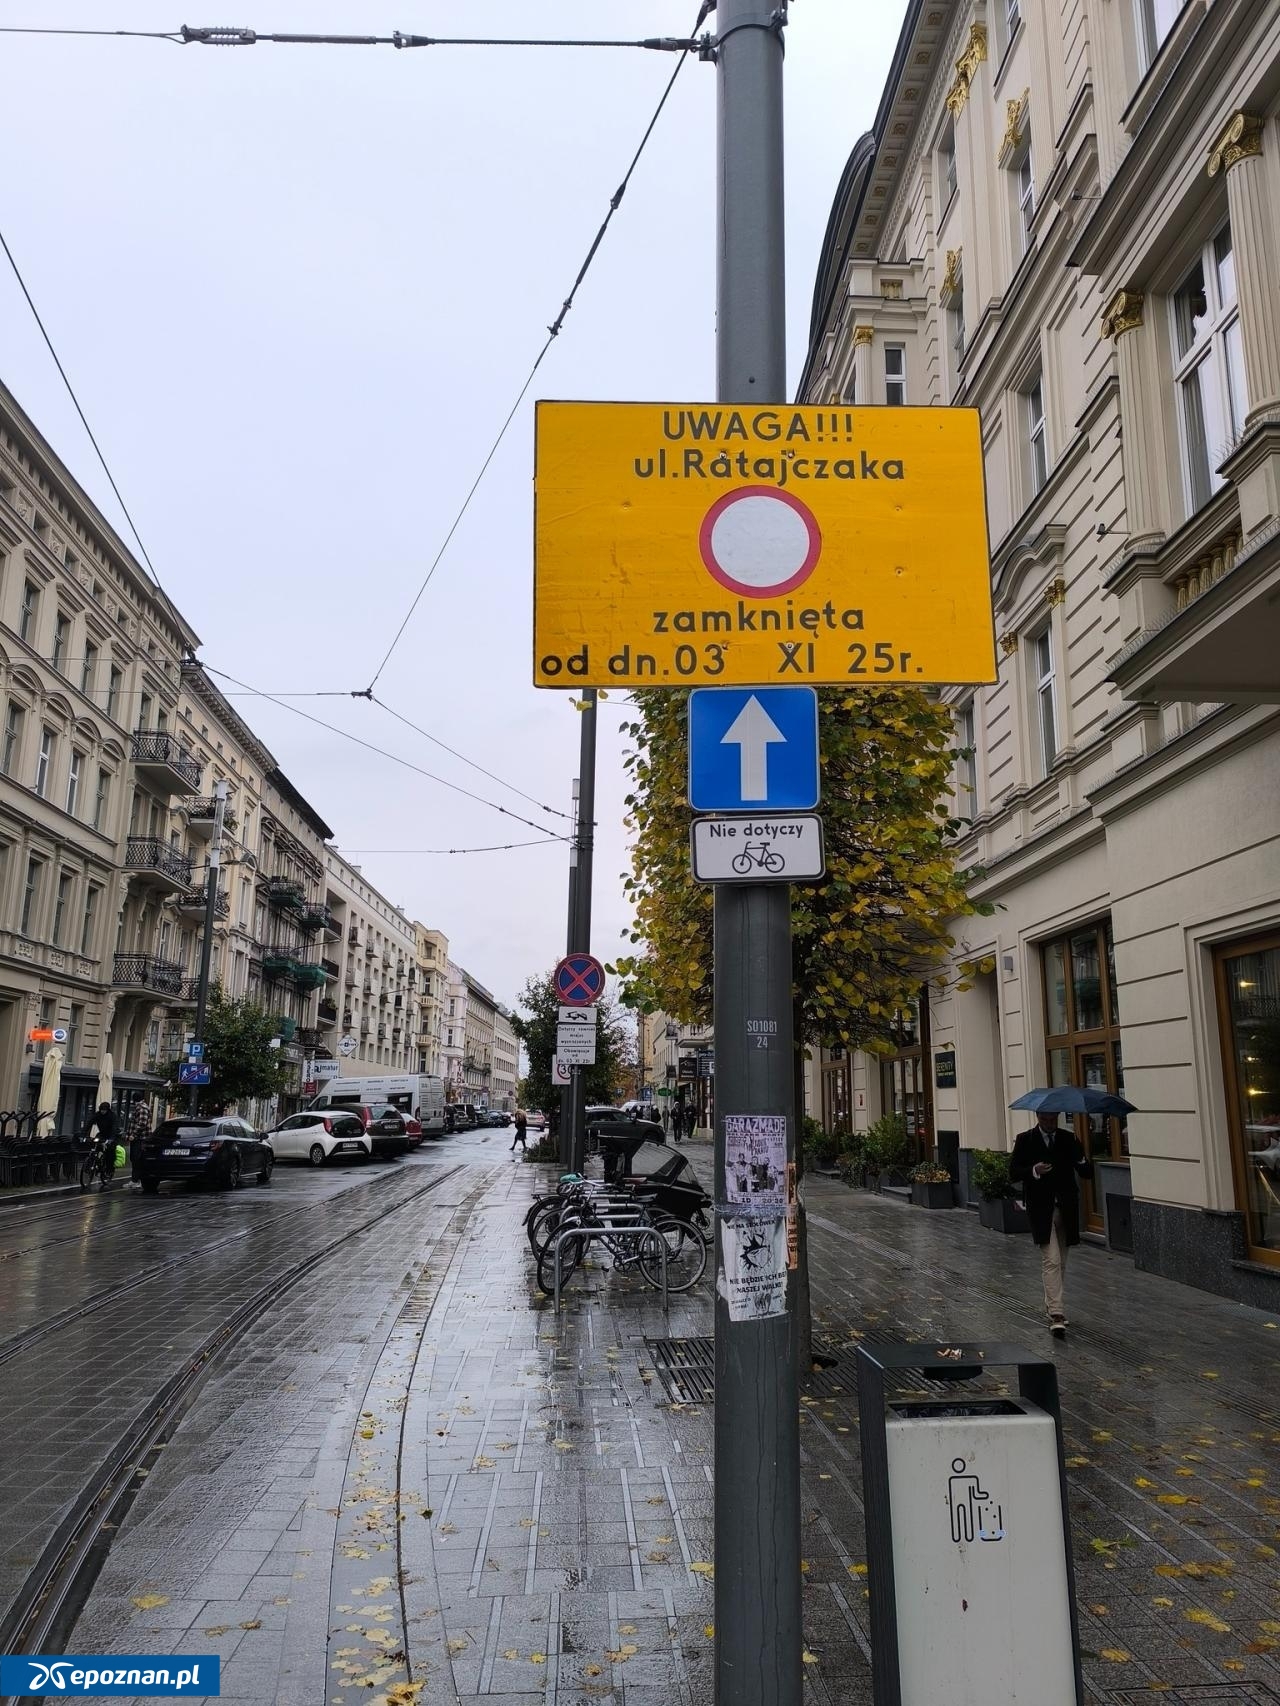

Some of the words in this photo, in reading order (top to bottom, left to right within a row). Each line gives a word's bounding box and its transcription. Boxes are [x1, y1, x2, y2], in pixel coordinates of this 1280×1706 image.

[662, 411, 854, 442] UWAGA!!!
[634, 449, 905, 486] ul.Ratajczaka
[653, 600, 865, 638] zamknięta
[540, 645, 589, 676] od
[608, 644, 725, 676] dn.03
[777, 642, 815, 674] XI
[848, 642, 924, 674] 25r.
[710, 824, 737, 838] Nie
[743, 823, 804, 840] dotyczy
[757, 1036, 768, 1048] 24
